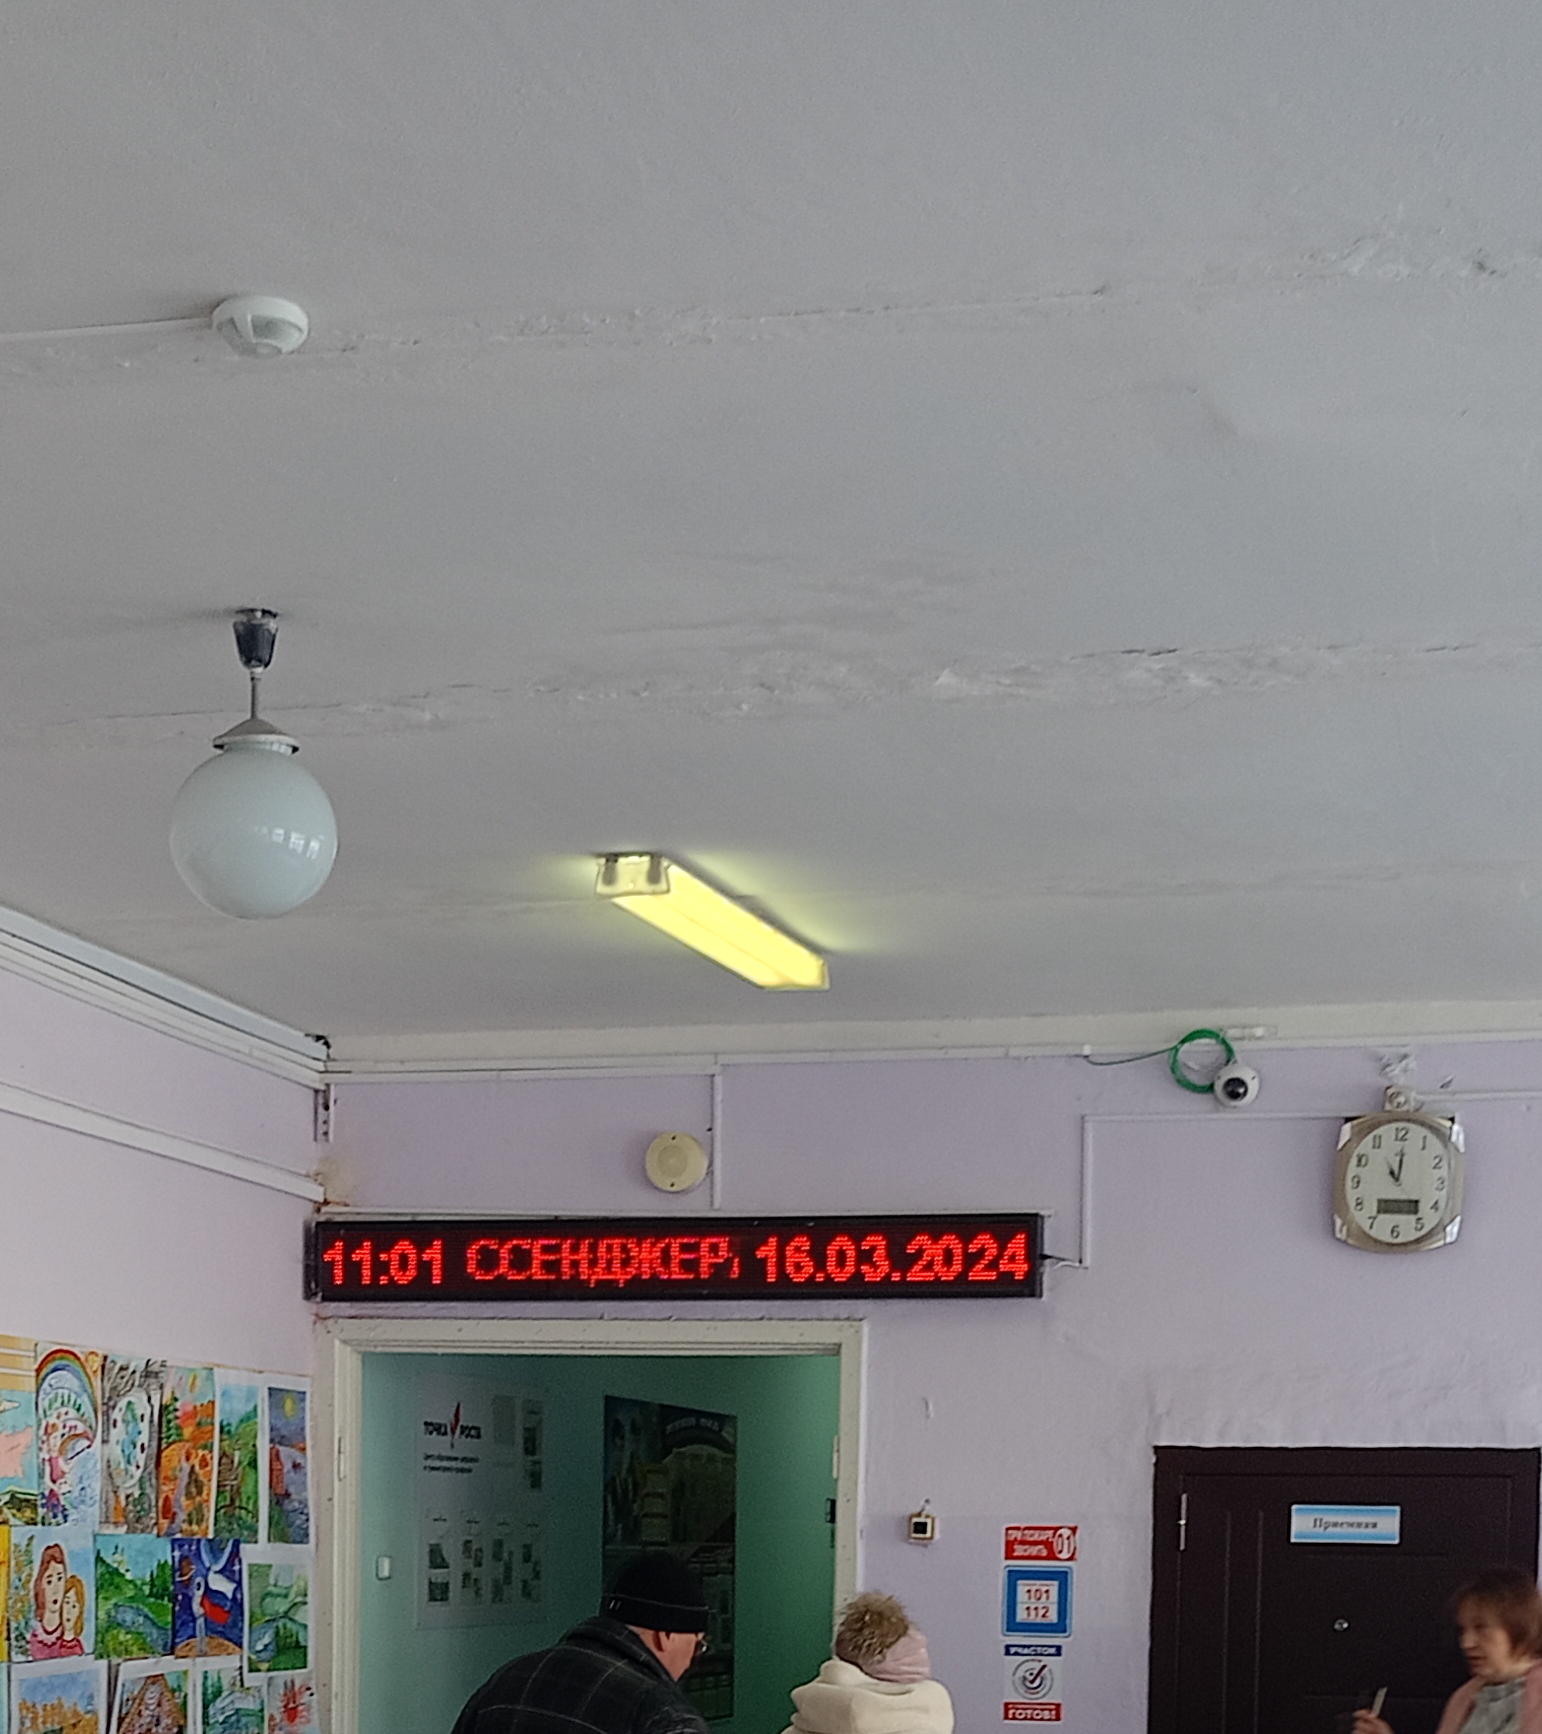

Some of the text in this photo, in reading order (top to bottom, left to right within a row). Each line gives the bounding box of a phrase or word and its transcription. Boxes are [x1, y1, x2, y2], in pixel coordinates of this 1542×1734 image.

[1394, 1126, 1409, 1142] 12
[1390, 1225, 1400, 1239] 6
[323, 1239, 444, 1286] 11:01
[756, 1233, 1028, 1283] 16.03.2024
[1057, 1532, 1071, 1555] 01
[1025, 1588, 1051, 1602] 101
[1024, 1605, 1050, 1619] 112
[1007, 1709, 1057, 1720] ГОТОВ!
